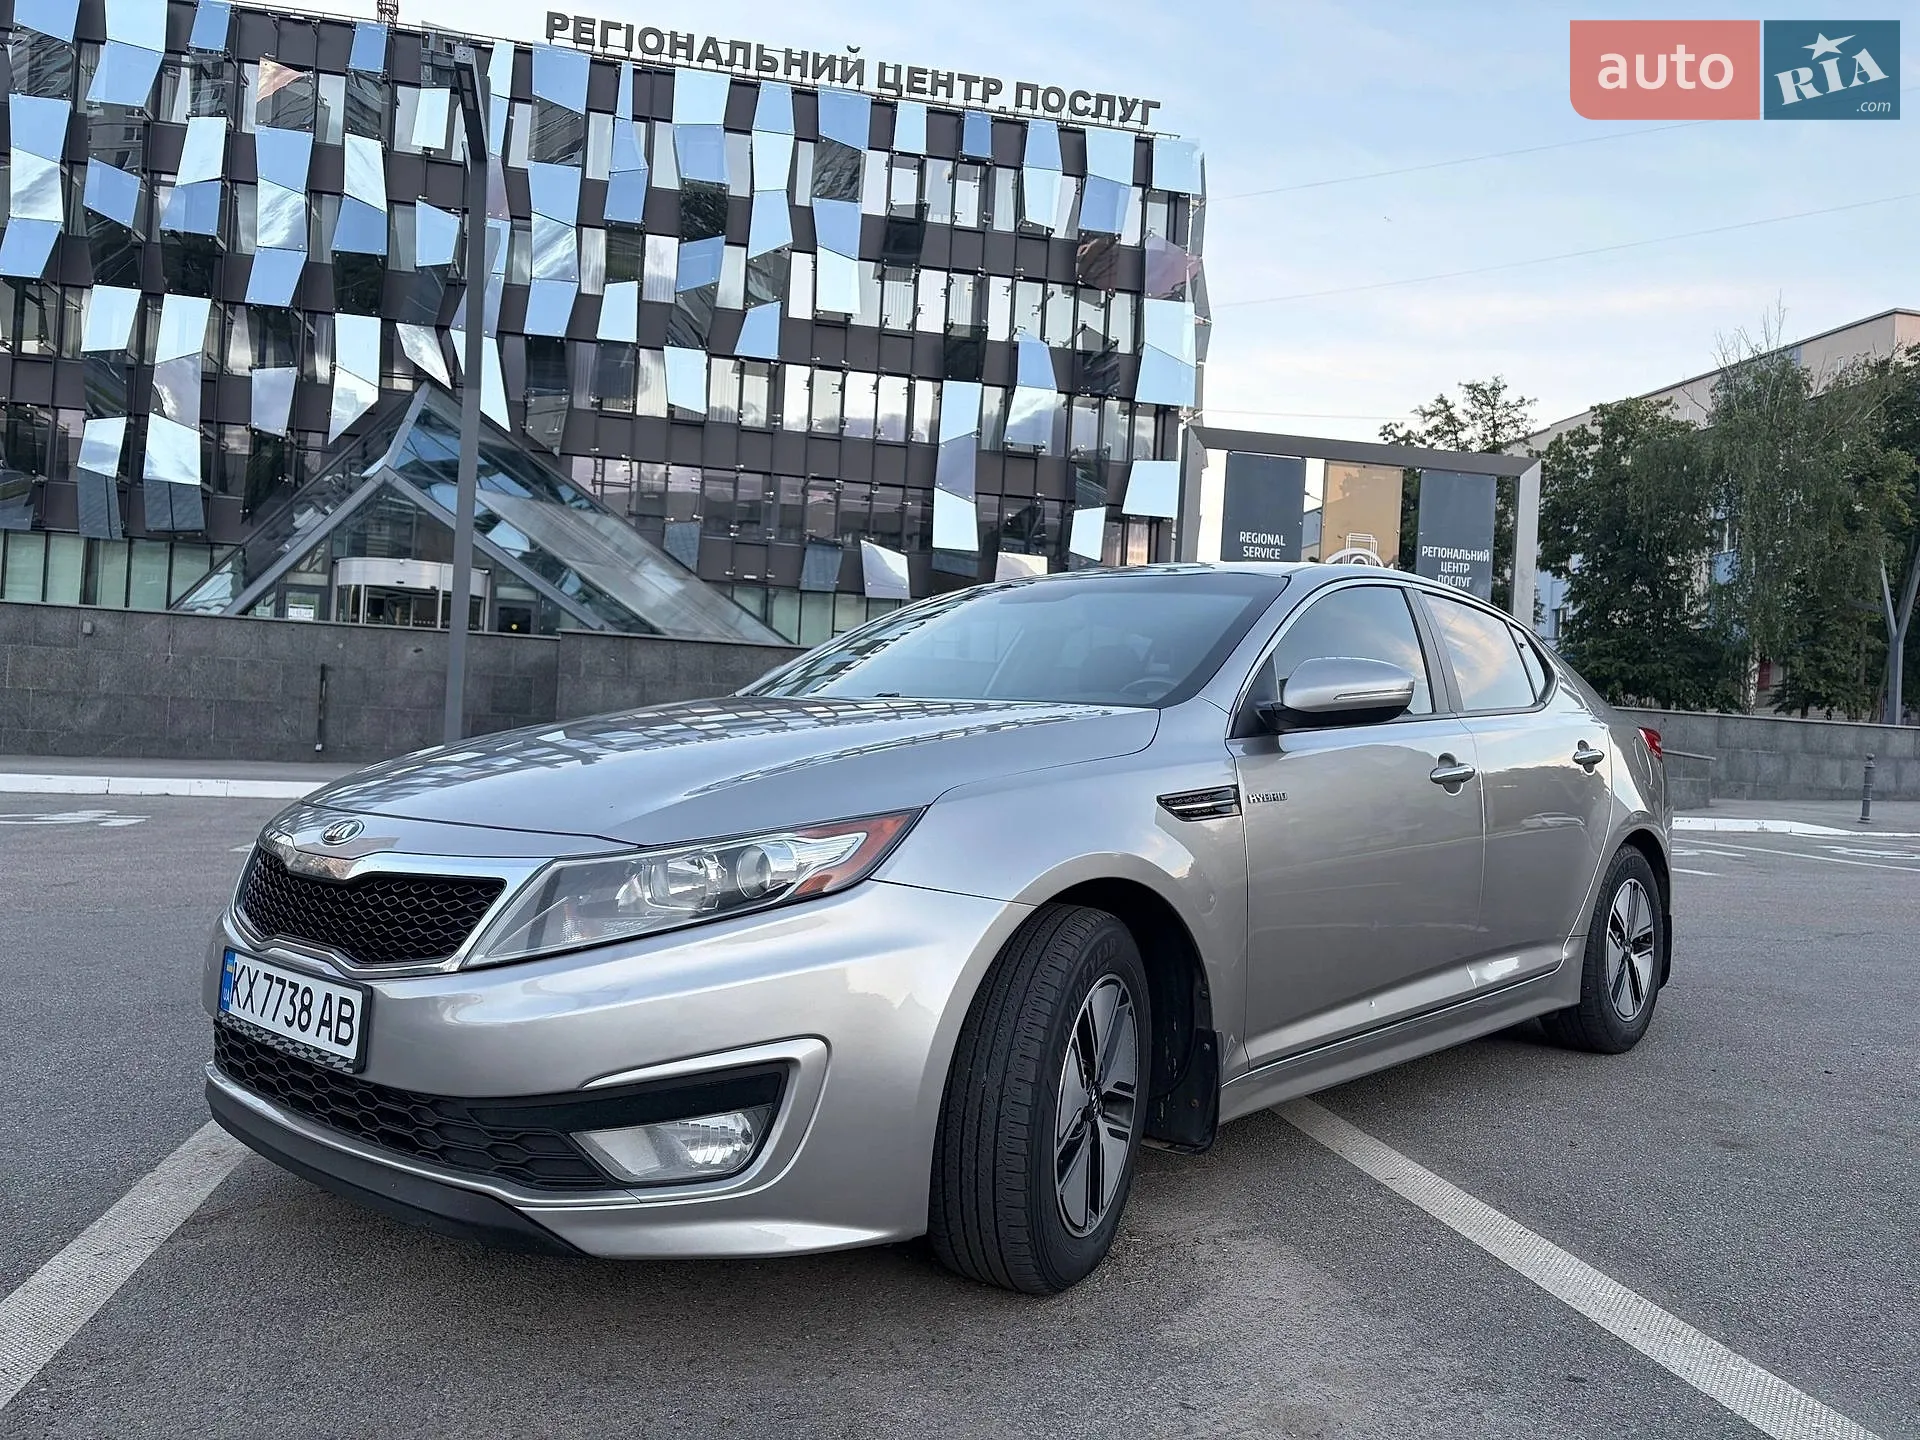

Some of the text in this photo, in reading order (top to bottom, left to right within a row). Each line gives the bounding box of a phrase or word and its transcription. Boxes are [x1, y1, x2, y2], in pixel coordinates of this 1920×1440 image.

[545, 11, 1161, 126] РЕГІОНАЛЬНИЙ ЦЕНТР ПОСЛУГ
[1239, 531, 1286, 547] REGIONAL
[1243, 545, 1281, 560] SERVICE
[1421, 545, 1490, 562] РЕГІОНАЛЬНИЙ
[1440, 561, 1470, 574] ЦЕНТР
[1437, 574, 1472, 588] ПОСЛУГ
[260, 972, 315, 1033] 7738
